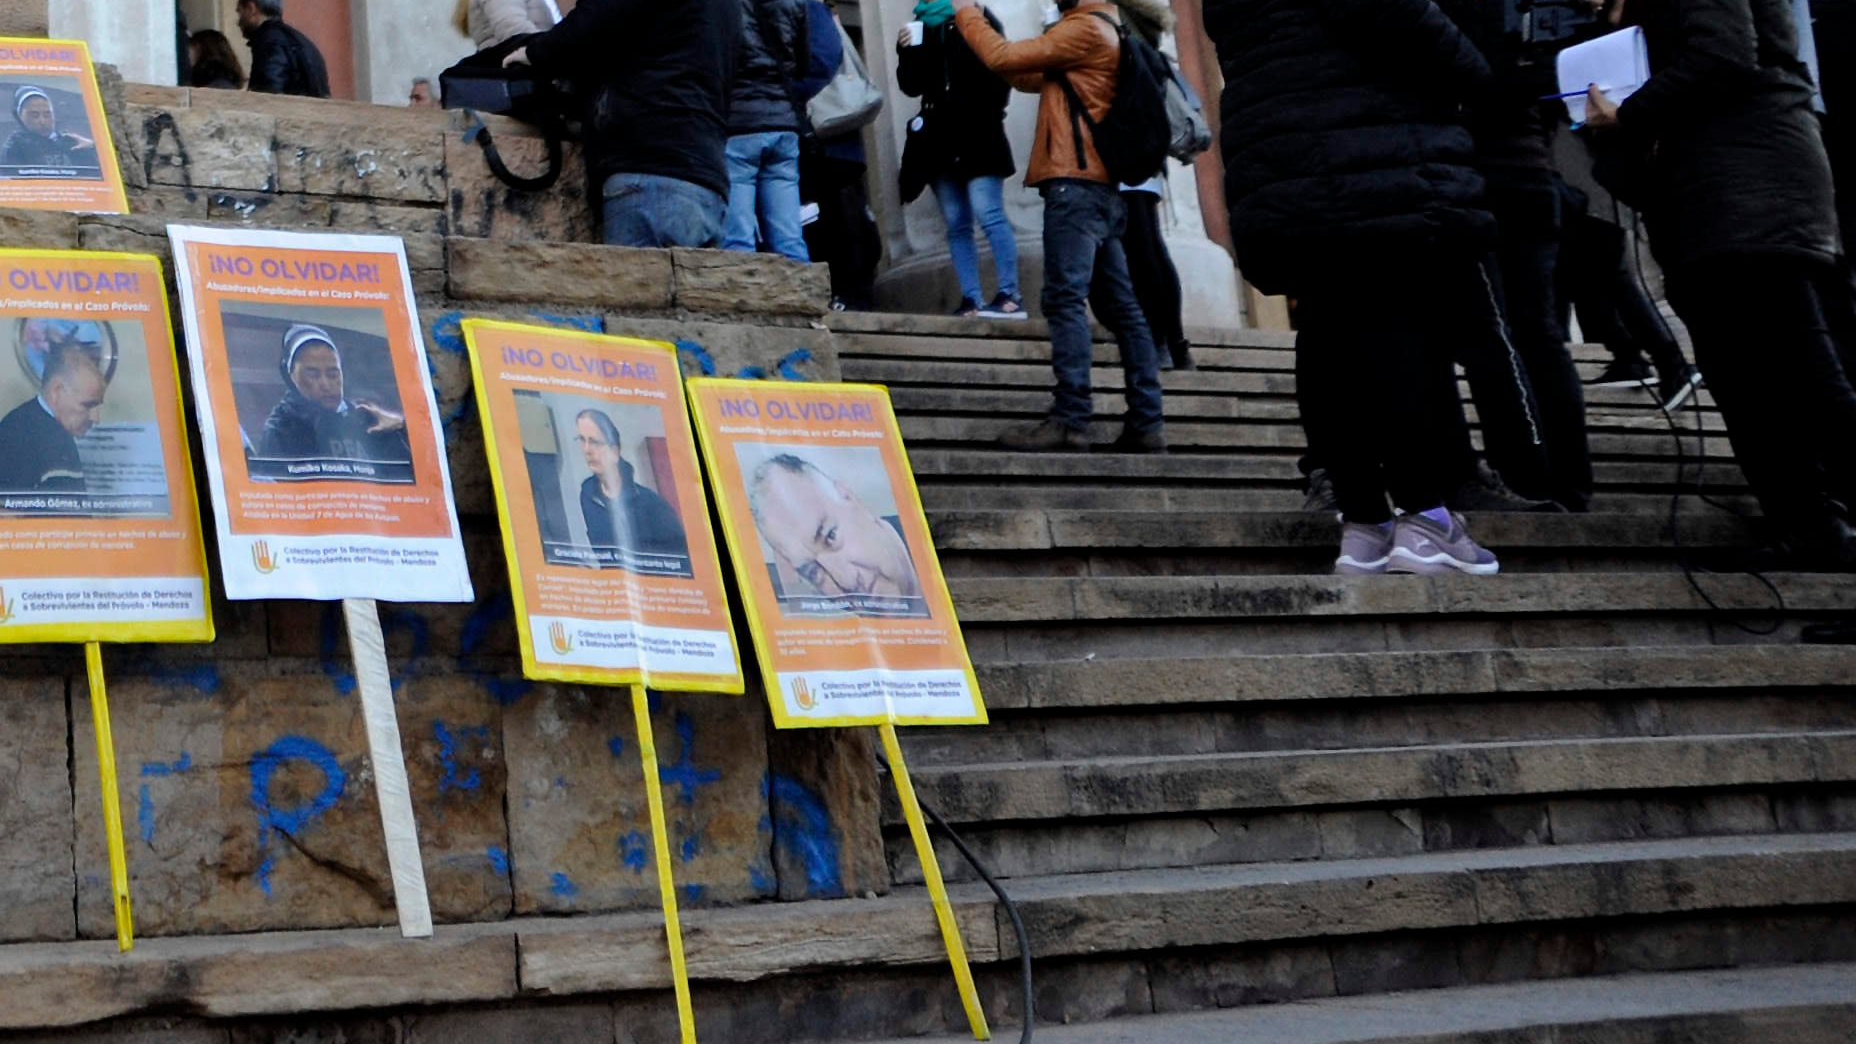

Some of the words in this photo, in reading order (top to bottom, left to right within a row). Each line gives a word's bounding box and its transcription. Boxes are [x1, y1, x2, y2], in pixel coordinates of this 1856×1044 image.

[9, 268, 139, 292] OLVIDAR!
[208, 255, 252, 276] ¡NO
[260, 258, 380, 283] OLVIDAR!
[60, 302, 73, 310] en
[74, 302, 84, 311] el
[84, 301, 109, 311] Caso
[502, 347, 543, 367] ¡NO
[551, 351, 656, 381] OLVIDAR!
[719, 398, 759, 418] ¡NO
[766, 399, 872, 421] OLVIDAR!
[20, 590, 64, 601] Colectivo
[65, 591, 81, 602] por
[92, 589, 139, 599] Restitución
[140, 589, 152, 599] de
[153, 589, 193, 599] Derechos
[29, 600, 95, 611] Sobrevivientes
[96, 600, 110, 610] del
[111, 600, 145, 610] Próvolo
[151, 600, 189, 609] Mendoza
